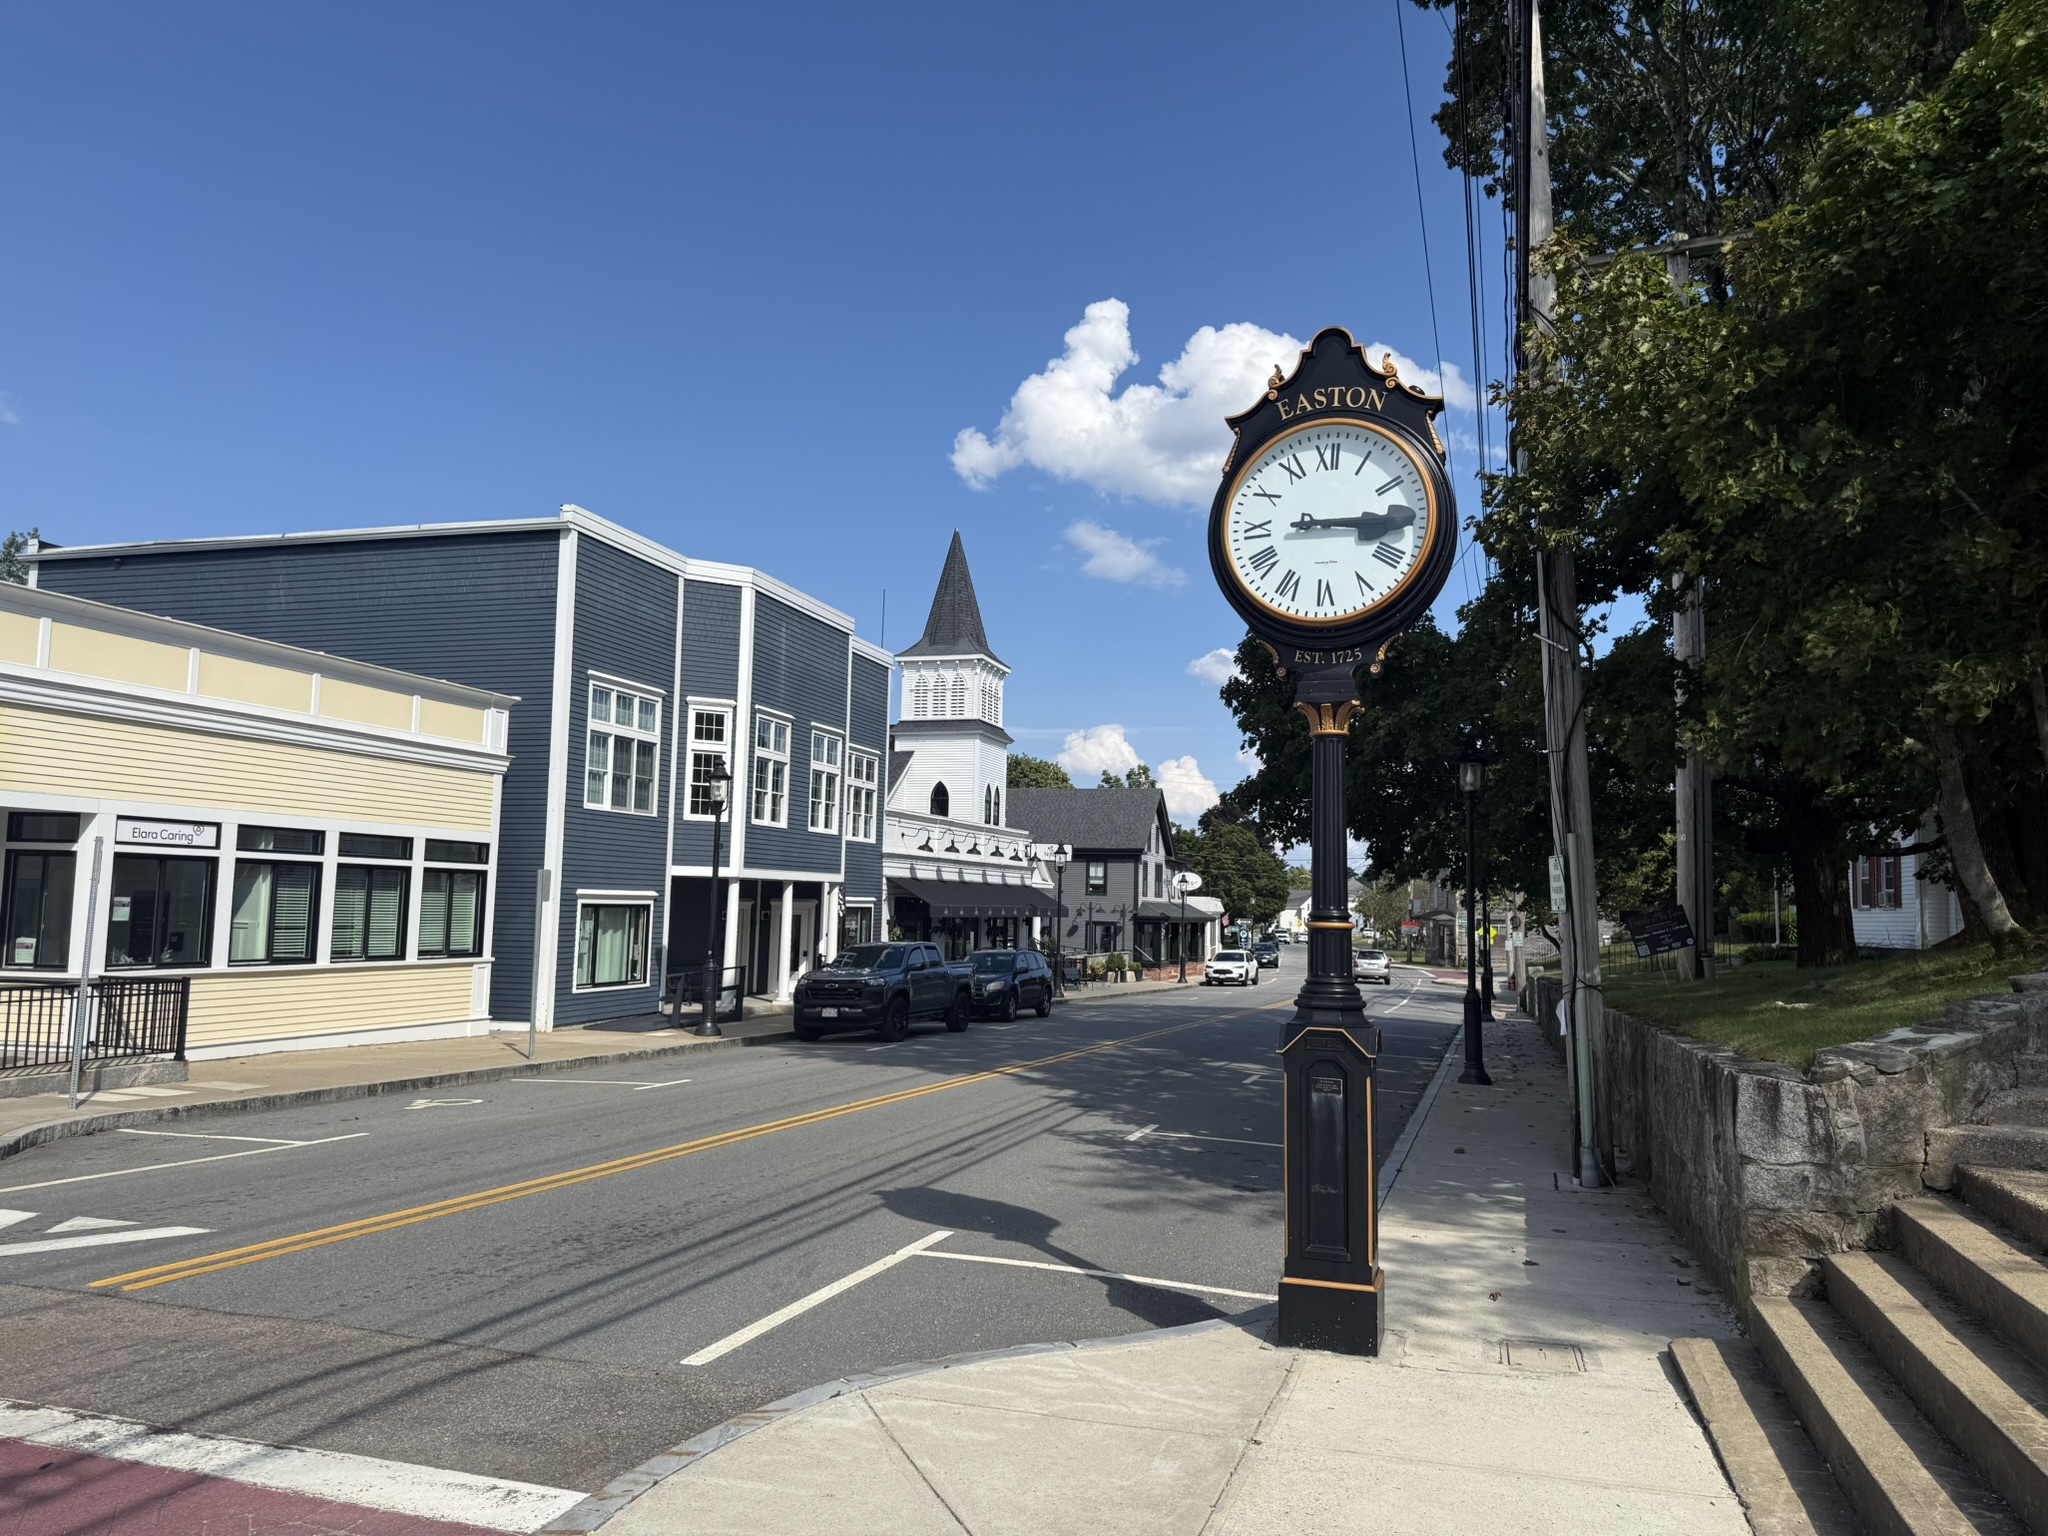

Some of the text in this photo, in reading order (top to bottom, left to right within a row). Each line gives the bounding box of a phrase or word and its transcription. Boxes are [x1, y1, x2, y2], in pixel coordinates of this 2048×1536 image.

[1275, 386, 1389, 421] EASTON
[1278, 453, 1307, 485] XI
[1315, 442, 1341, 472] XII
[1252, 485, 1282, 507] X
[1375, 475, 1404, 497] II
[1244, 519, 1272, 541] IX
[1248, 545, 1281, 581] VIII
[1274, 569, 1301, 602] VII
[1317, 578, 1335, 607] VI
[1354, 570, 1375, 597] V
[1294, 647, 1362, 664] EST. 1725
[132, 827, 194, 845] Elara Caring
